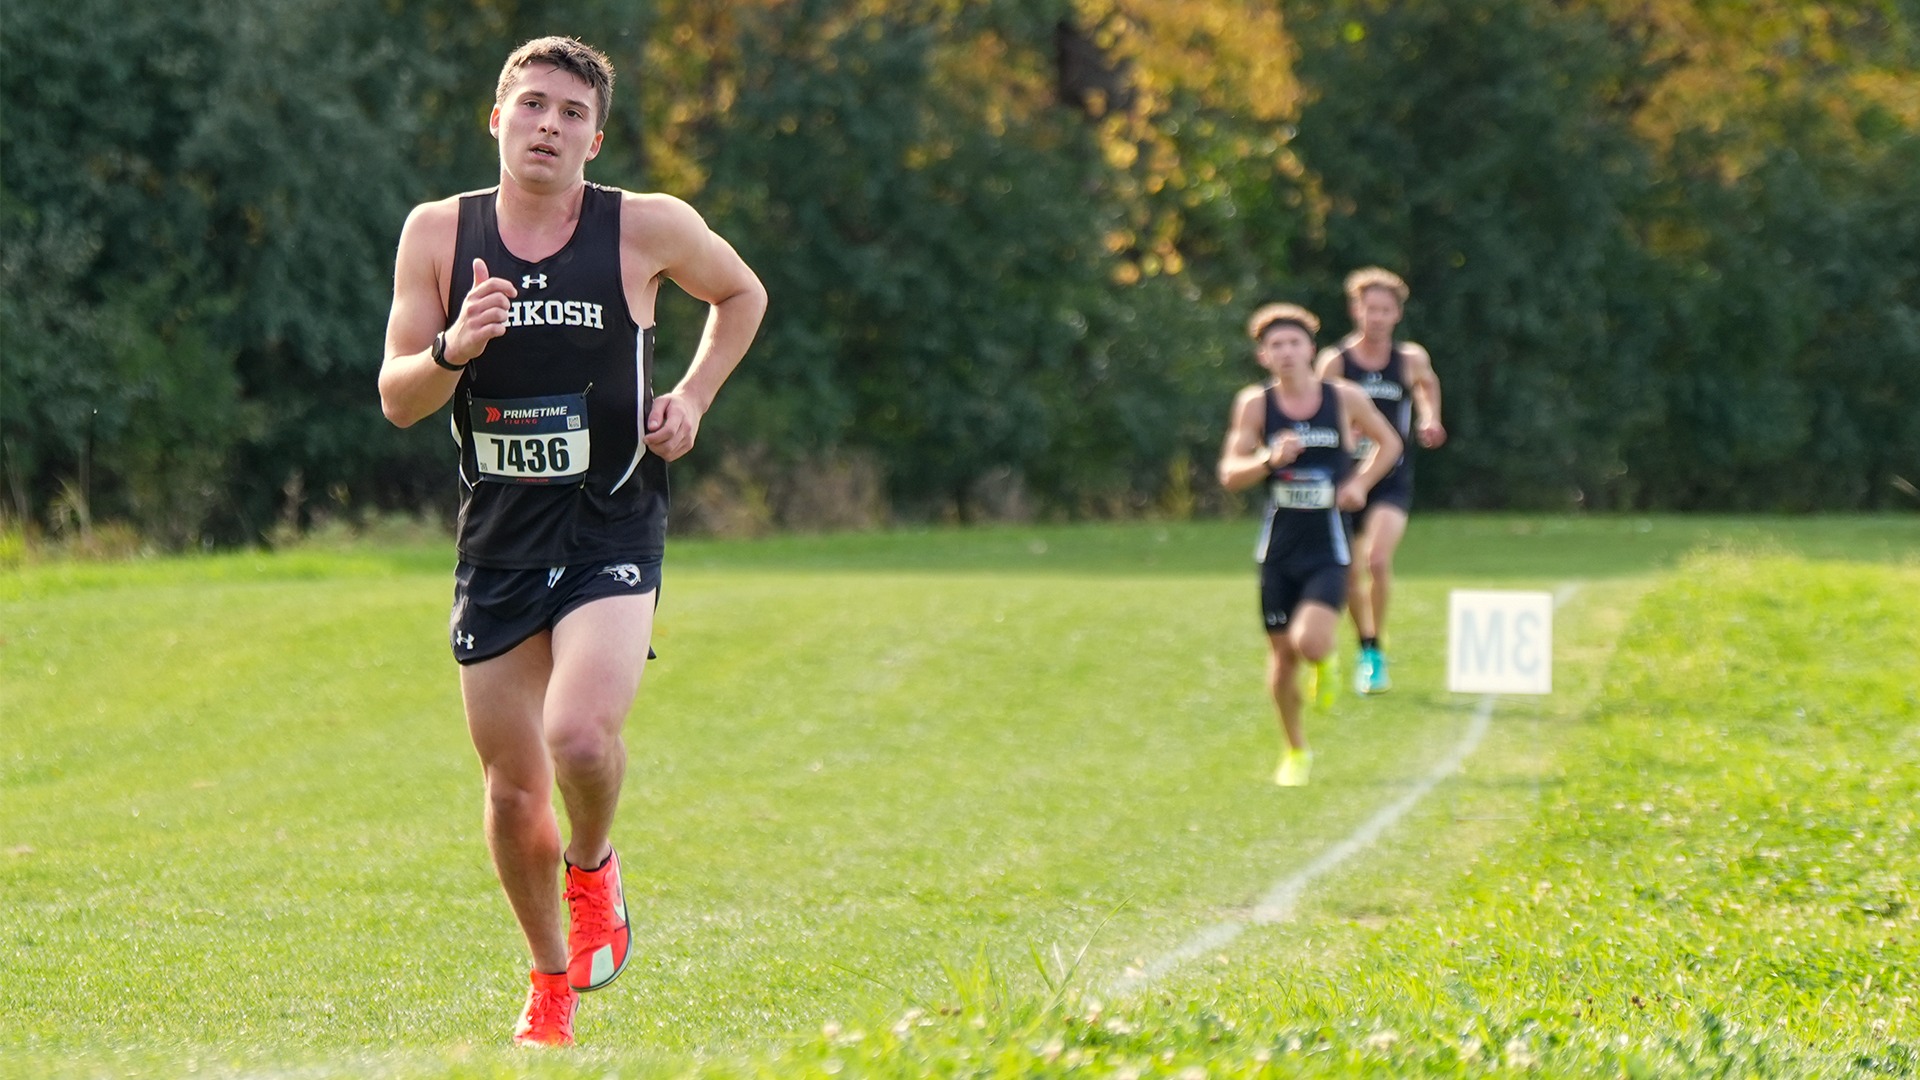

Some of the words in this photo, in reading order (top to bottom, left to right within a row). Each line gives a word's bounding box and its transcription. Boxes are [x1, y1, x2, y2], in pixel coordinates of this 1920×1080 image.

[502, 300, 604, 330] HKOSH
[503, 406, 568, 419] PRIMETIME
[490, 437, 570, 473] 7436
